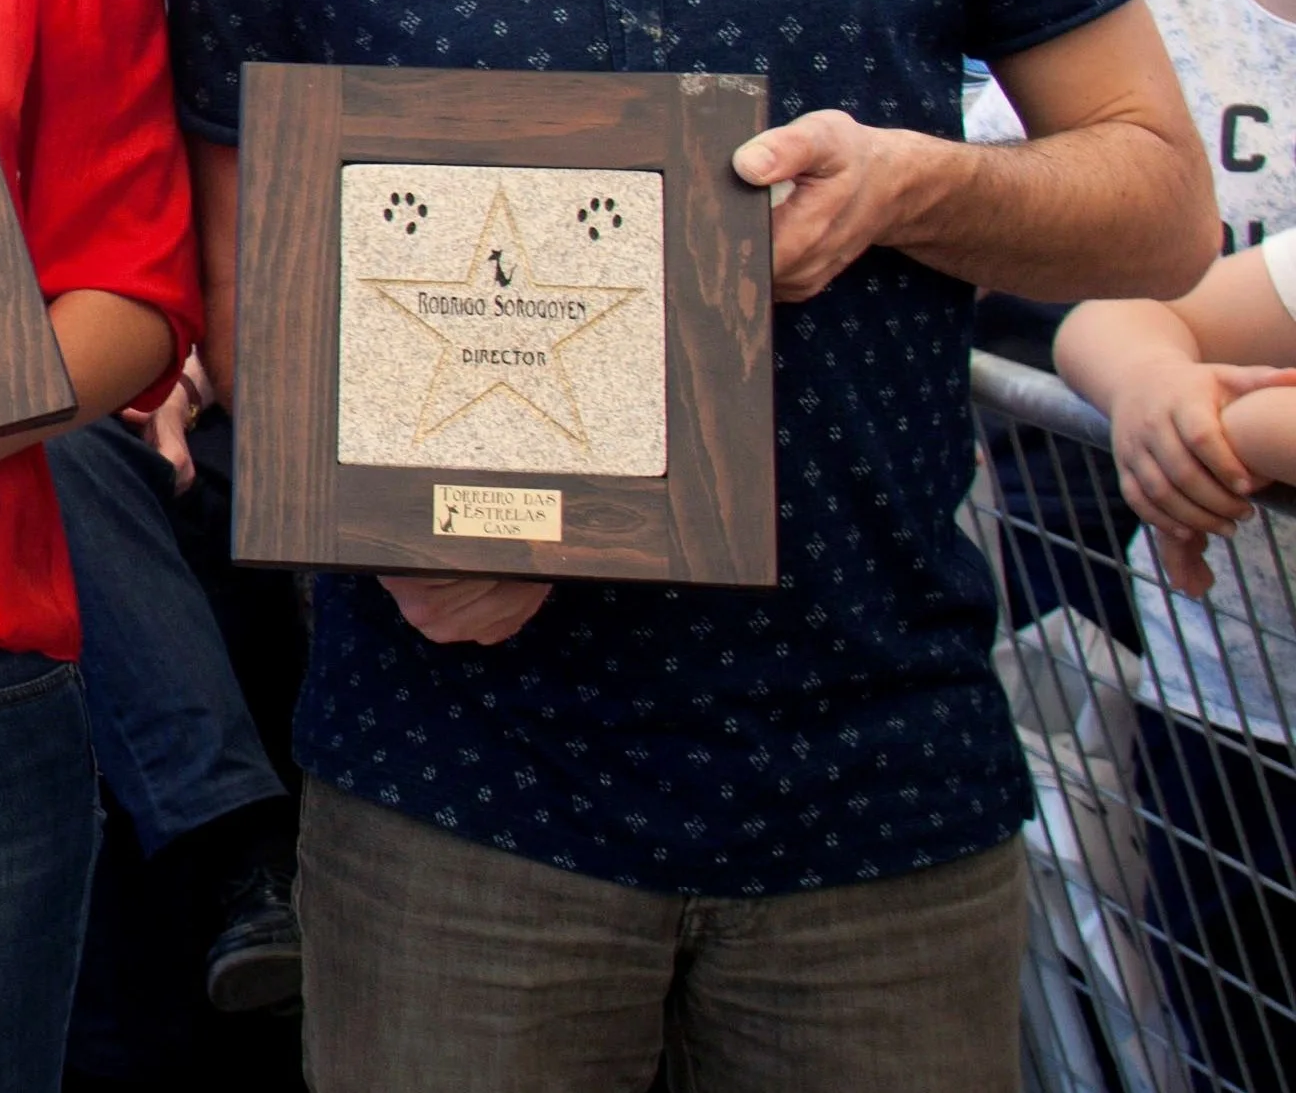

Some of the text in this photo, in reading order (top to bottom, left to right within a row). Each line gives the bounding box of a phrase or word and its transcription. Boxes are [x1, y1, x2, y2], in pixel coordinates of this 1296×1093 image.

[418, 291, 587, 320] RODRIGO SOROGOYEN
[462, 348, 547, 367] DIRECTOR
[440, 486, 557, 506] TORREIRO DAS
[463, 504, 546, 522] ESTRELAS
[483, 521, 521, 535] CANS
